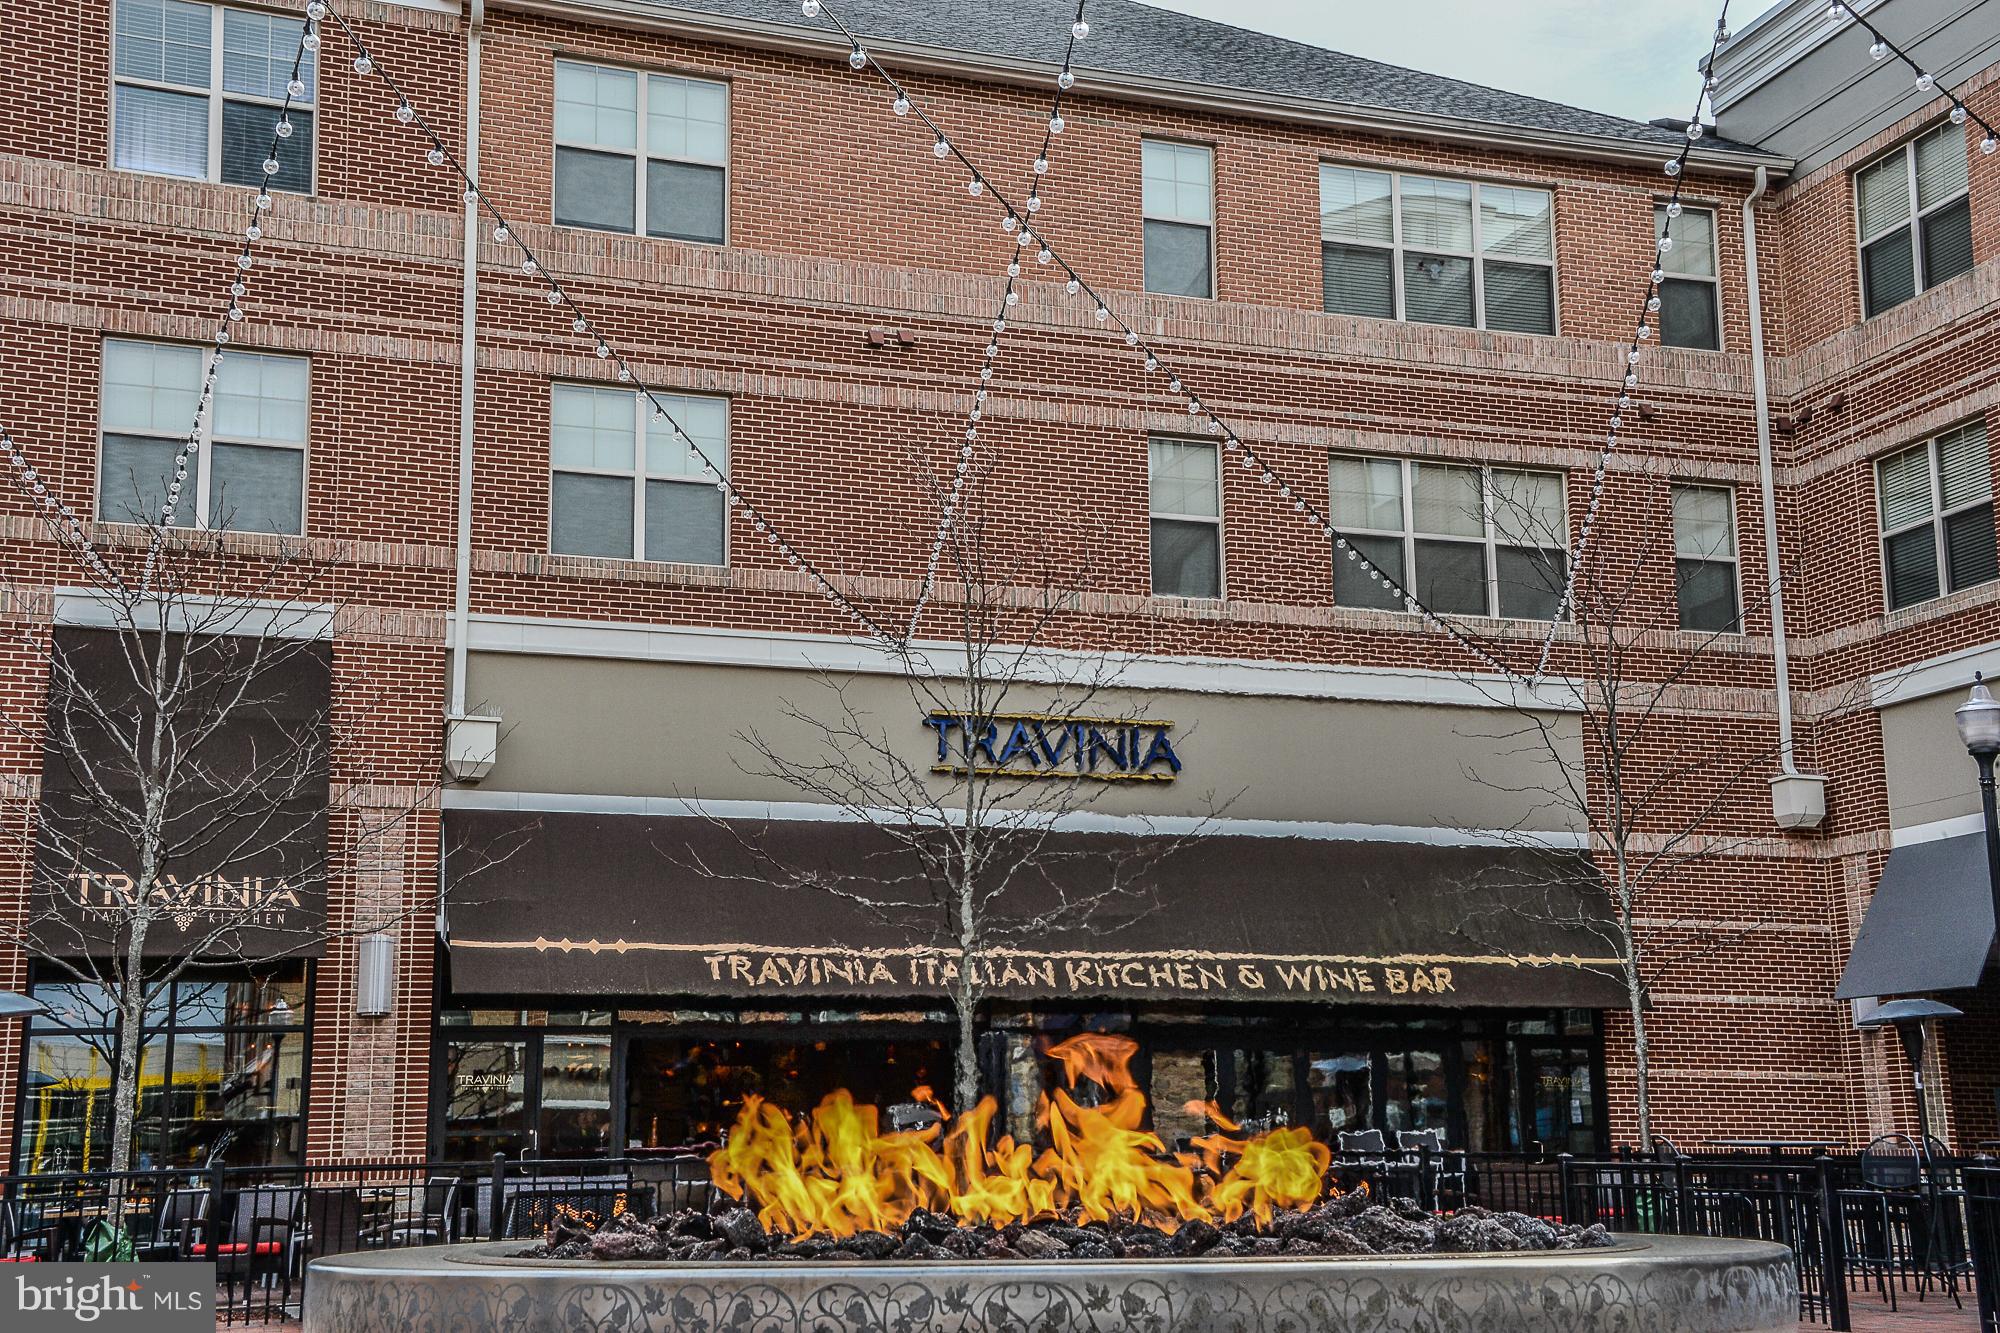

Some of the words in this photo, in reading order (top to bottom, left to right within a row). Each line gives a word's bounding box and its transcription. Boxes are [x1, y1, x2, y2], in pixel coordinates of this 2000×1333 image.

[922, 717, 1182, 773] TRAVINIA
[69, 873, 301, 907] TRAVINIA
[703, 956, 898, 986] TRAVINIA
[908, 957, 1056, 988] ITALIAN
[1065, 959, 1227, 991] KITCHEN
[1238, 964, 1265, 990] &
[1275, 964, 1376, 993] WINE
[1385, 967, 1457, 994] BAR
[457, 1074, 515, 1084] TRAVINIA
